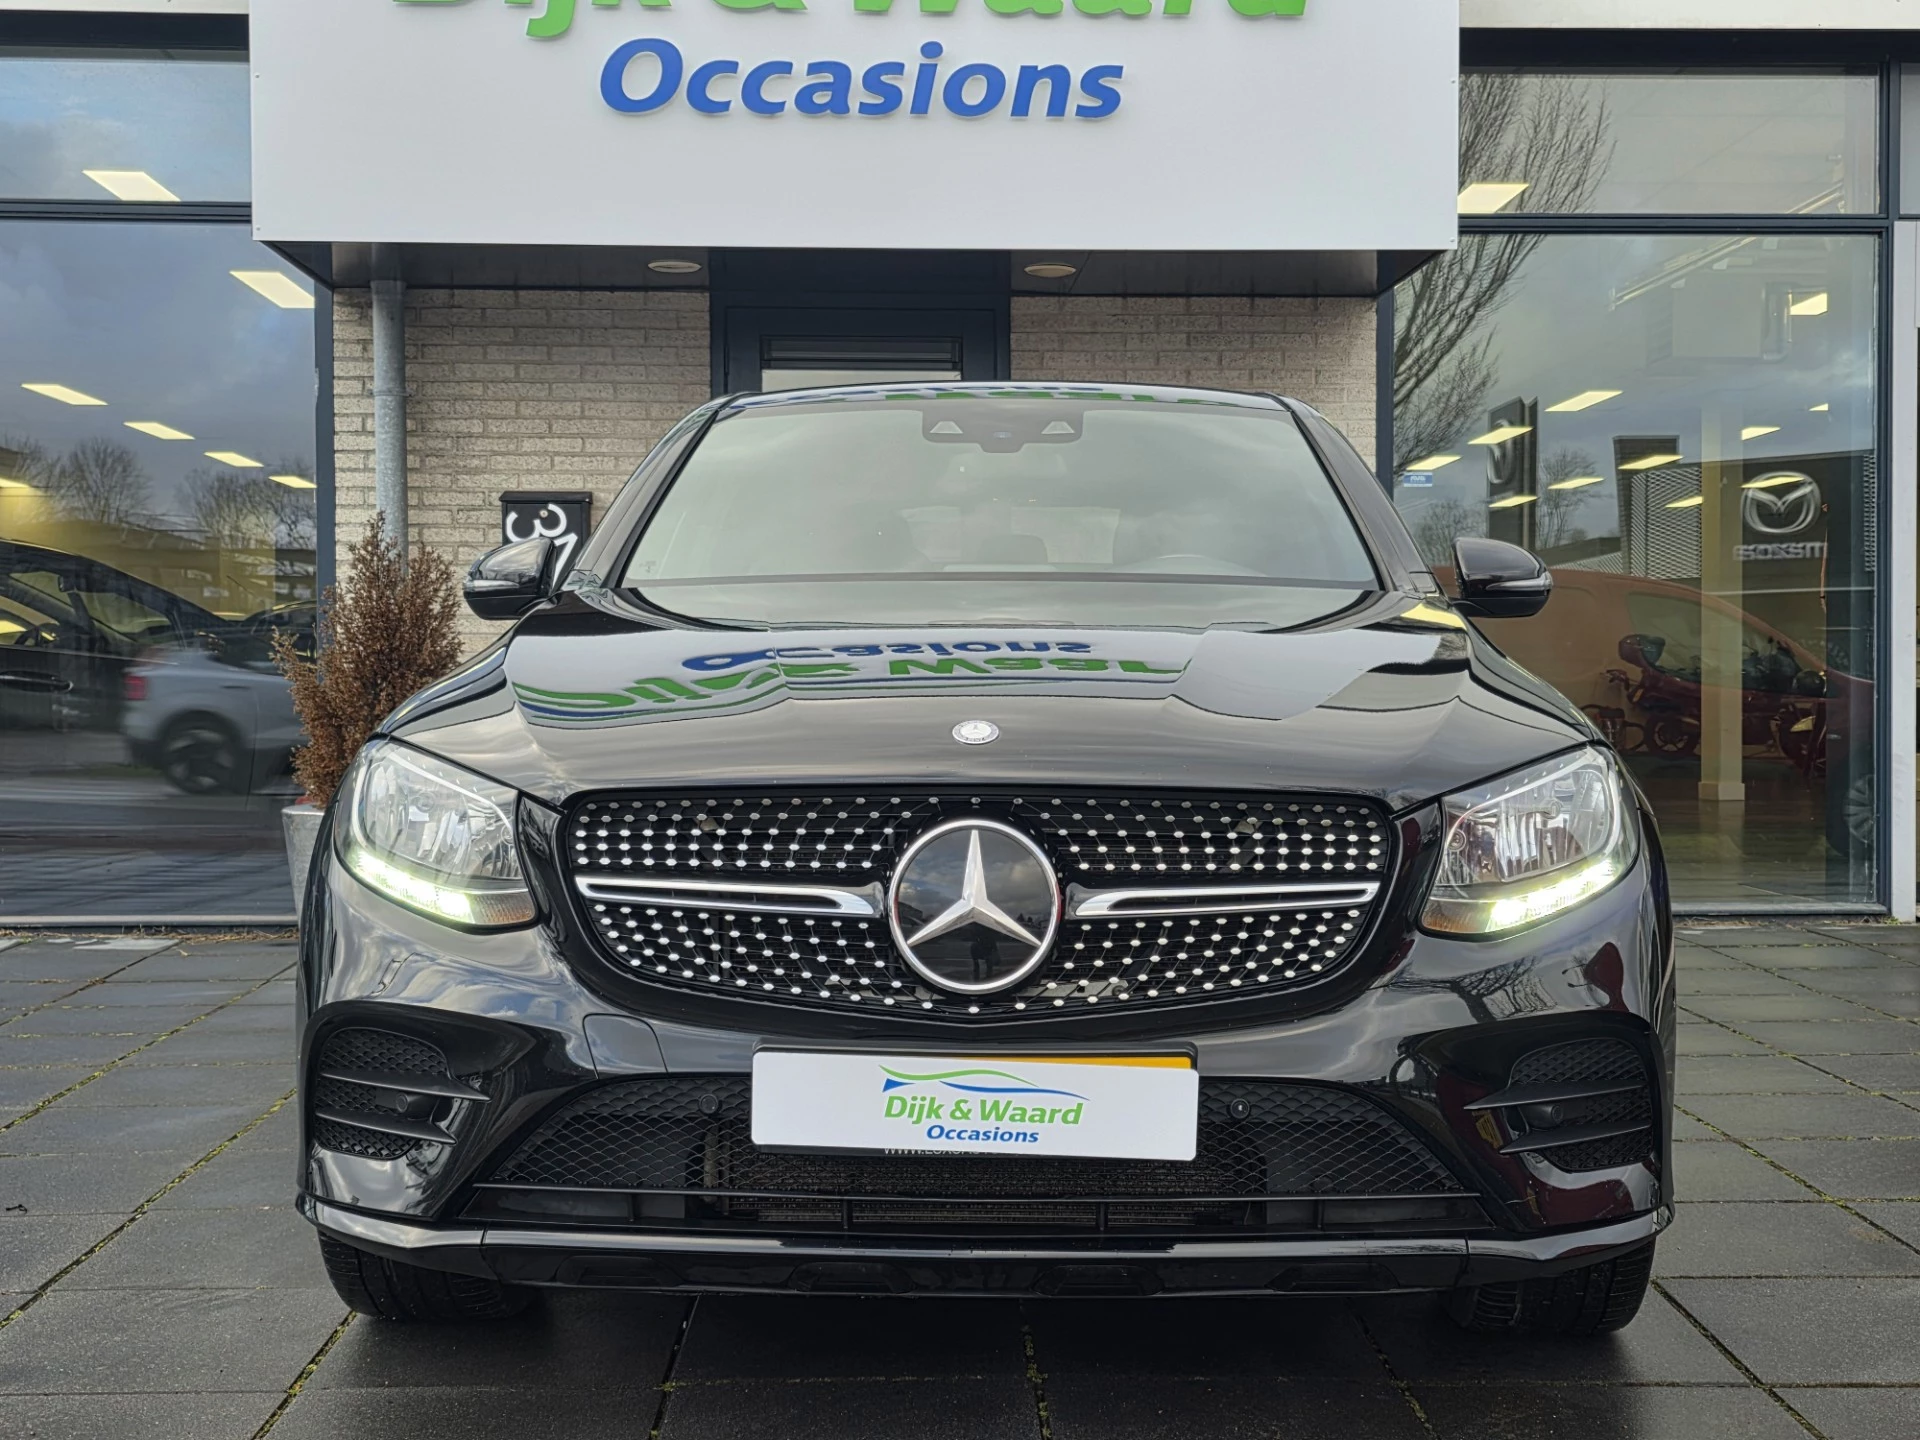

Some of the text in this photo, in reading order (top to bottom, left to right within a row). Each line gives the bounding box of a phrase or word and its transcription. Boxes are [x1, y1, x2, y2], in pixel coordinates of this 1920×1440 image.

[600, 38, 1124, 118] Occasions
[884, 1095, 1084, 1125] Dijk & Waard
[926, 1125, 1040, 1143] Occasions
